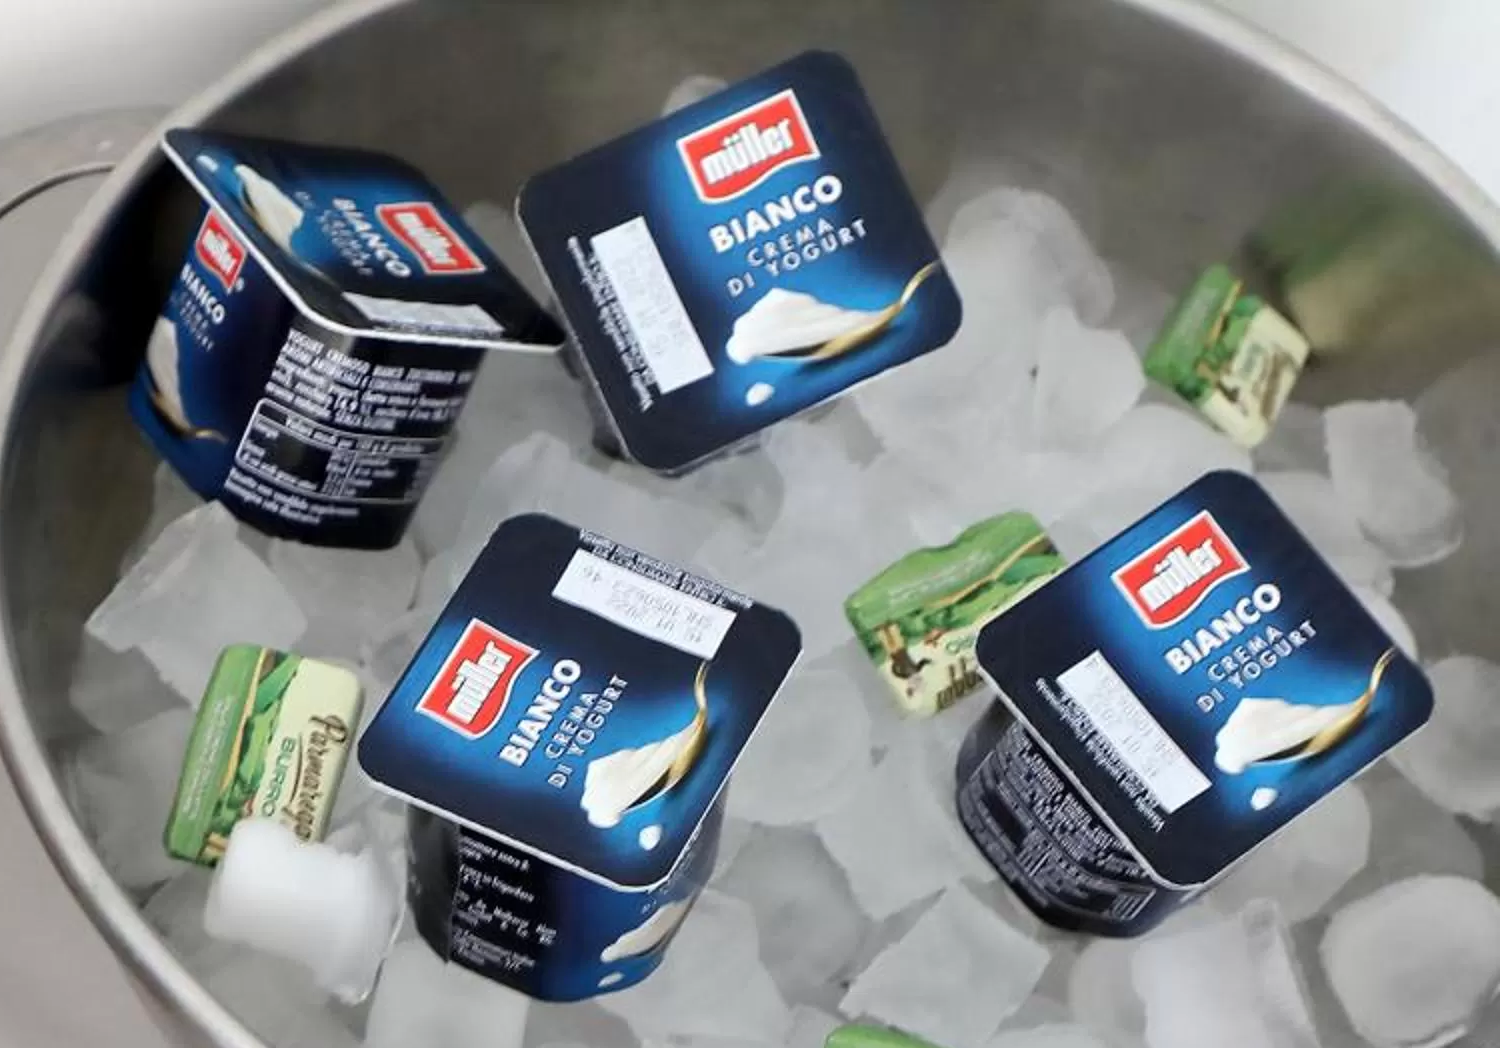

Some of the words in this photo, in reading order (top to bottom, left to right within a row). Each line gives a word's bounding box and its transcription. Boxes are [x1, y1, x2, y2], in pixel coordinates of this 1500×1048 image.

[699, 117, 794, 185] müller
[332, 198, 412, 277] BIANCO
[708, 174, 842, 253] BIANCO
[747, 217, 835, 268] CREMA
[726, 276, 756, 299] DI
[764, 218, 869, 278] YOGURT
[1138, 538, 1225, 613] müller
[1163, 582, 1283, 676] BIANCO
[1196, 687, 1226, 715] DI
[1226, 619, 1317, 692] YOGURT
[1207, 623, 1284, 684] CREMA
[446, 639, 514, 724] müller
[499, 657, 582, 768] BIANCO
[545, 691, 598, 761] CREMA
[548, 763, 574, 789] DI
[569, 673, 630, 758] YOGURT
[261, 736, 296, 818] BURRO
